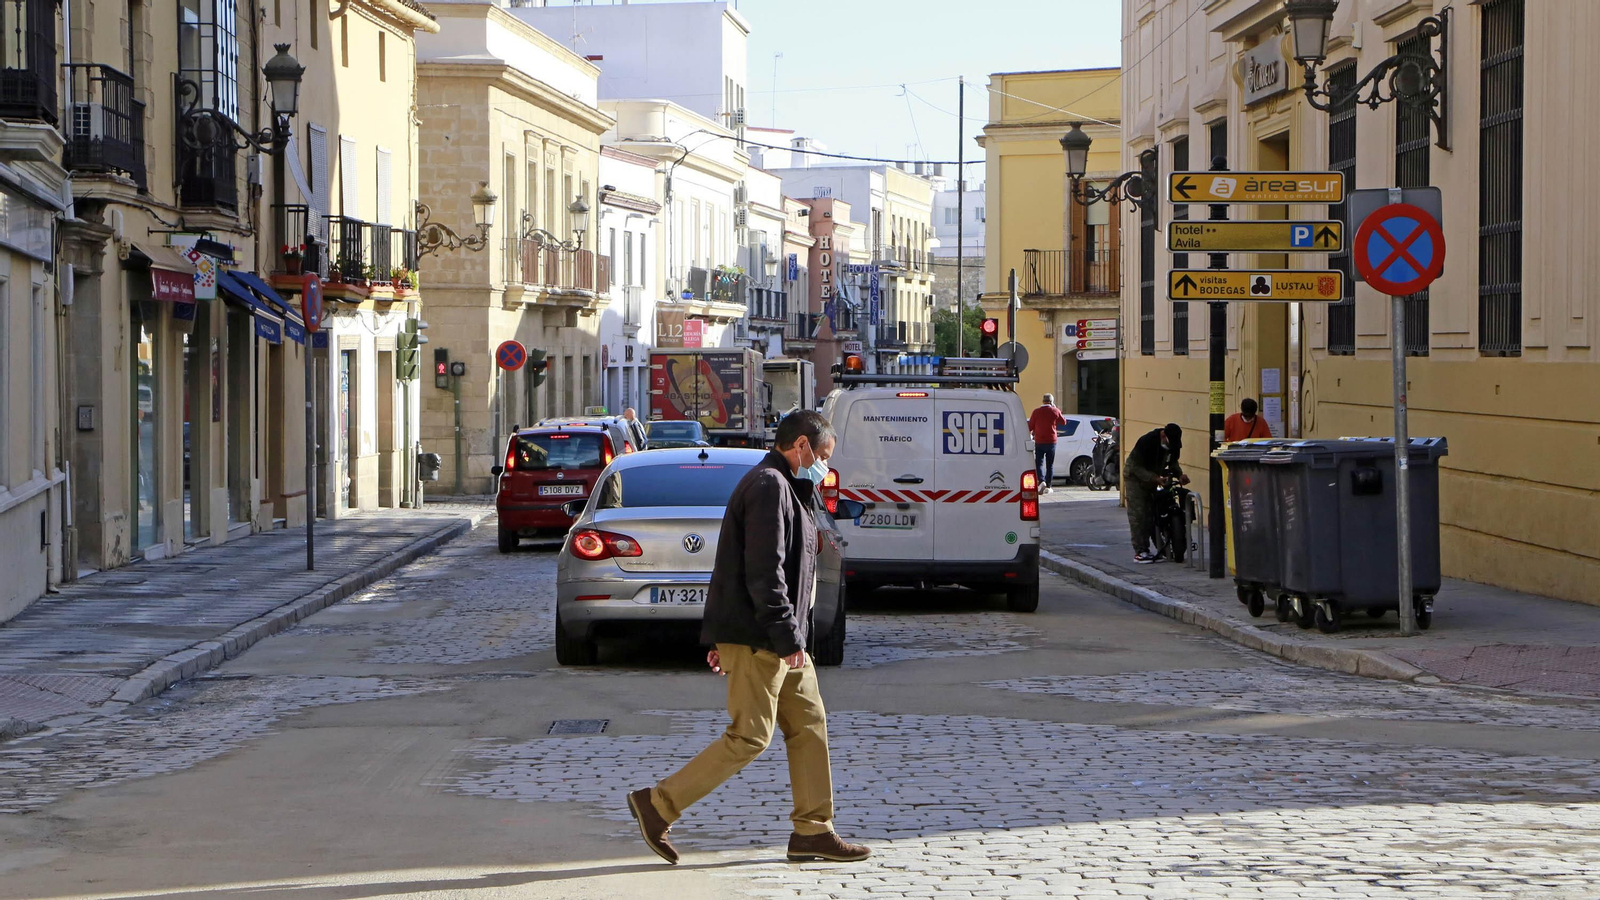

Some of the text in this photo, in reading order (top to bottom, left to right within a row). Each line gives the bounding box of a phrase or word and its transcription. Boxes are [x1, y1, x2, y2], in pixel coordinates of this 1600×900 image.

[1175, 225, 1309, 245] hotel P
[1175, 238, 1201, 248] Avila
[848, 264, 878, 273] HOTEL
[1200, 275, 1227, 284] visitas
[1200, 282, 1314, 295] BODEGAS LUSTAU
[657, 322, 683, 338] L12
[844, 343, 862, 351] HOTEL
[863, 415, 928, 423] MANTENIMIENTO
[947, 412, 1001, 455] SICE
[879, 435, 912, 443] TRÁFICO
[543, 485, 580, 494] 5108 DVZ
[862, 513, 917, 526] 7280 LDW
